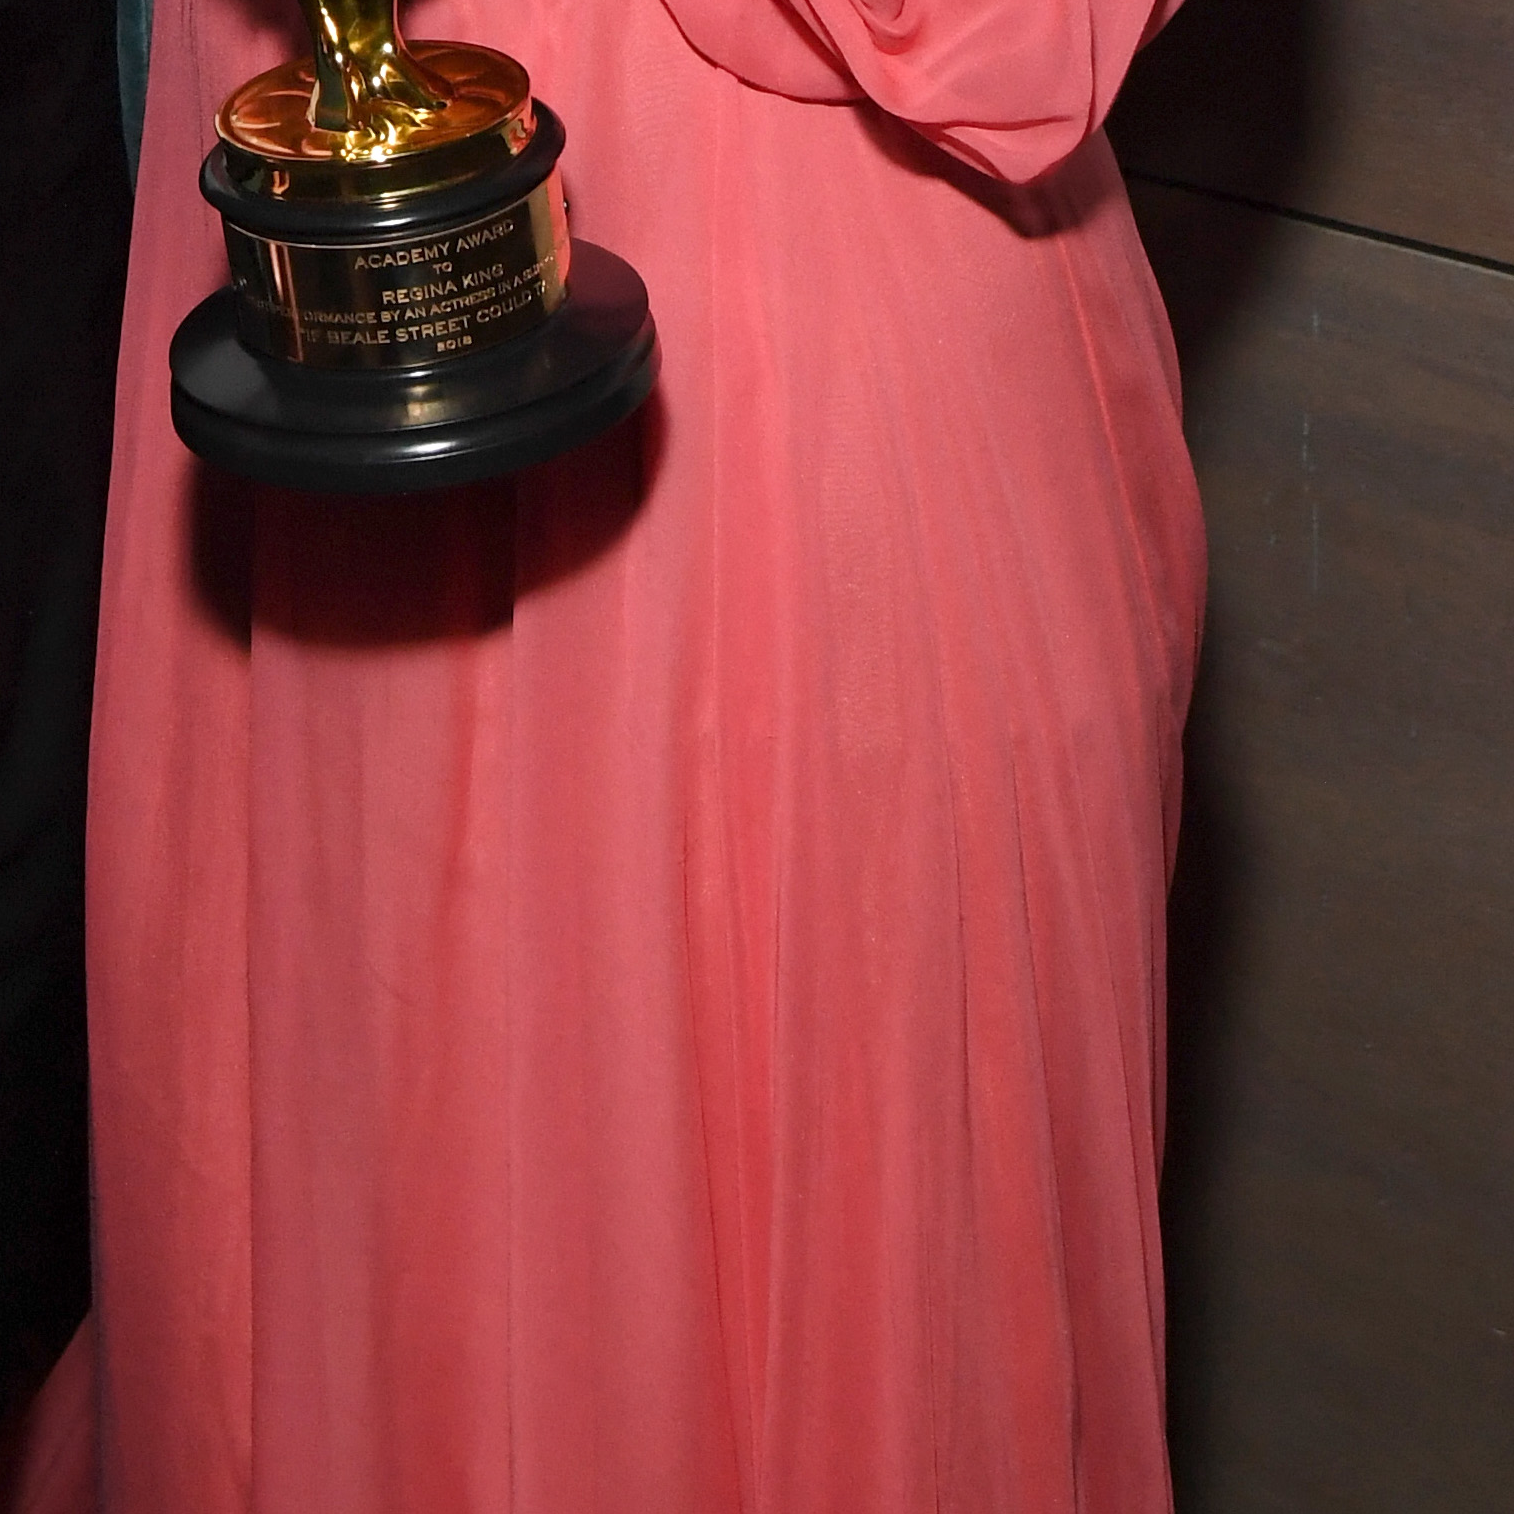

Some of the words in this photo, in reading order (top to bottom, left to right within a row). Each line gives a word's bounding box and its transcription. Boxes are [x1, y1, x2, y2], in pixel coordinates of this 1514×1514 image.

[354, 241, 450, 270] ACADEMY
[456, 219, 514, 253] AWARD
[382, 280, 458, 305] REGINA
[462, 263, 504, 289] KING
[432, 261, 453, 275] TO
[327, 329, 391, 345] BEALE
[395, 314, 471, 343] STREET
[476, 289, 532, 323] COULD
[380, 309, 400, 323] BY
[404, 306, 427, 320] AN
[430, 286, 496, 316] ACTRESS
[498, 279, 512, 295] IN
[513, 275, 523, 288] A
[436, 334, 473, 353] 2018
